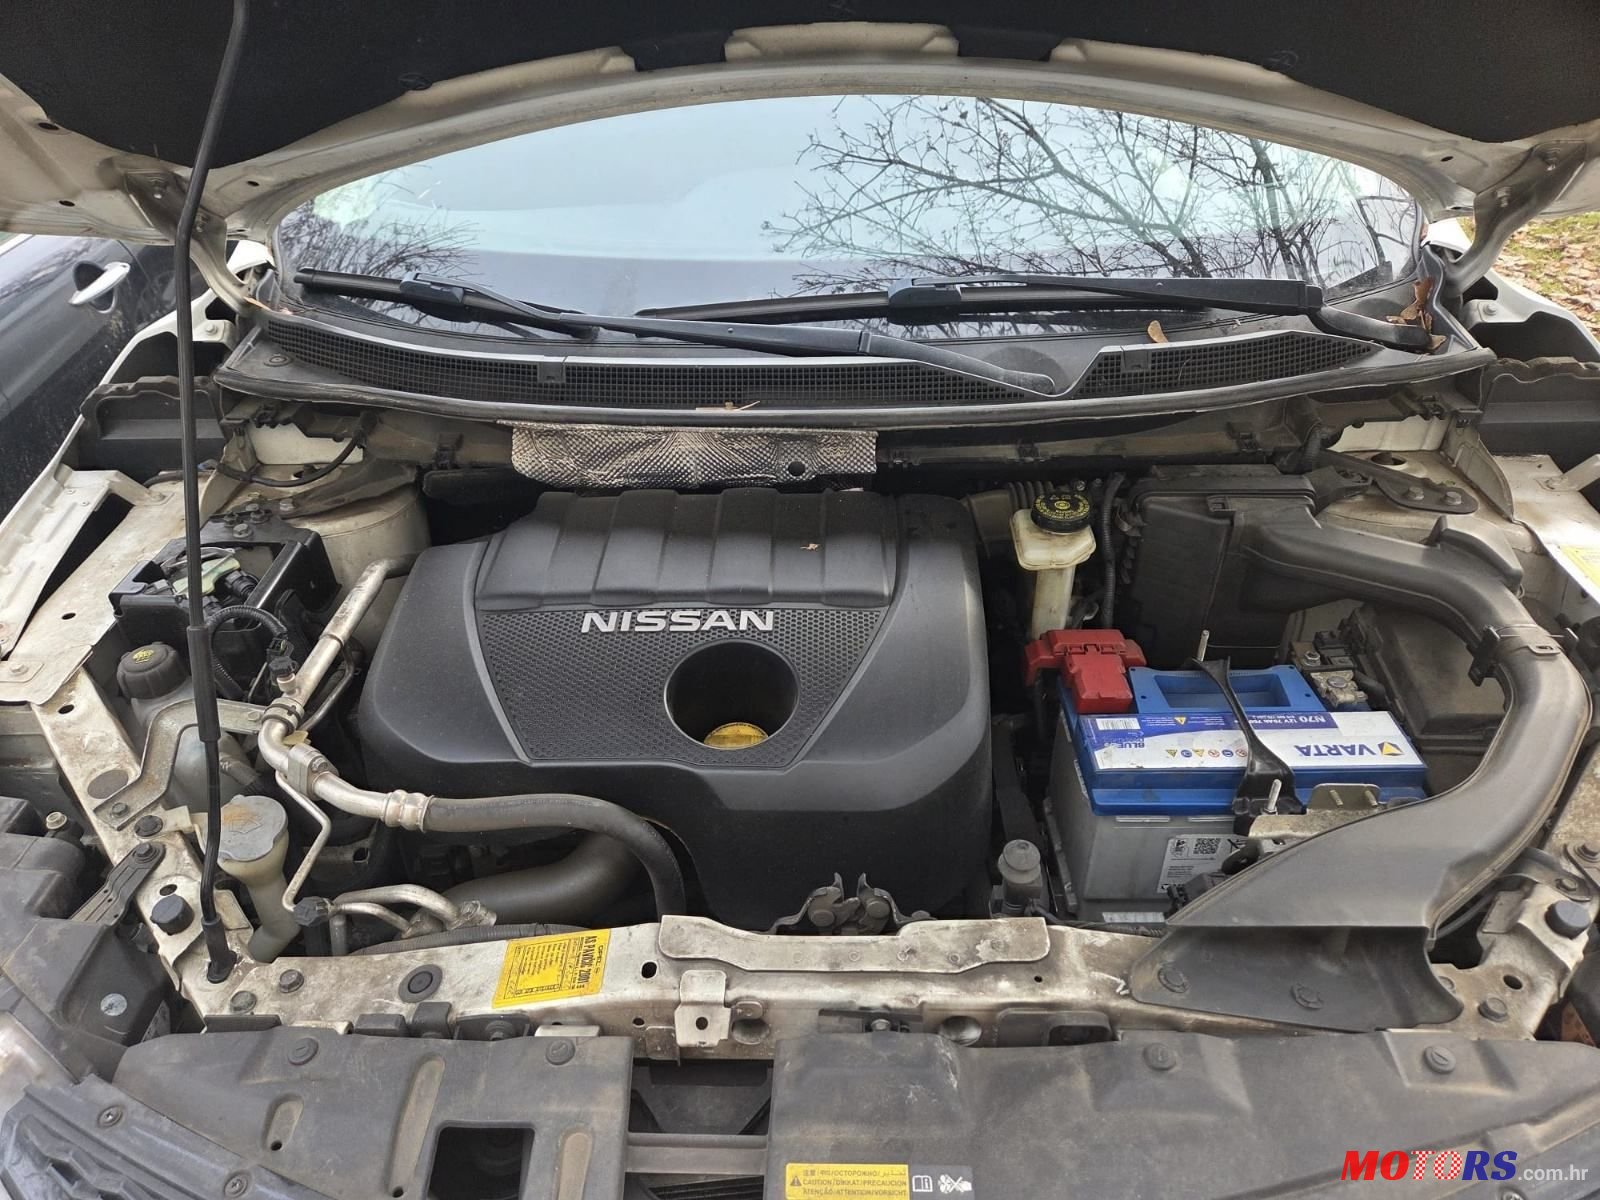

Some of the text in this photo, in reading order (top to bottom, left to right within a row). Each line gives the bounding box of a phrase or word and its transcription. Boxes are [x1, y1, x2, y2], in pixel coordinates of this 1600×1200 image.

[581, 610, 773, 633] NISSAN
[1299, 714, 1326, 723] N70
[1297, 743, 1376, 757] VARTA
